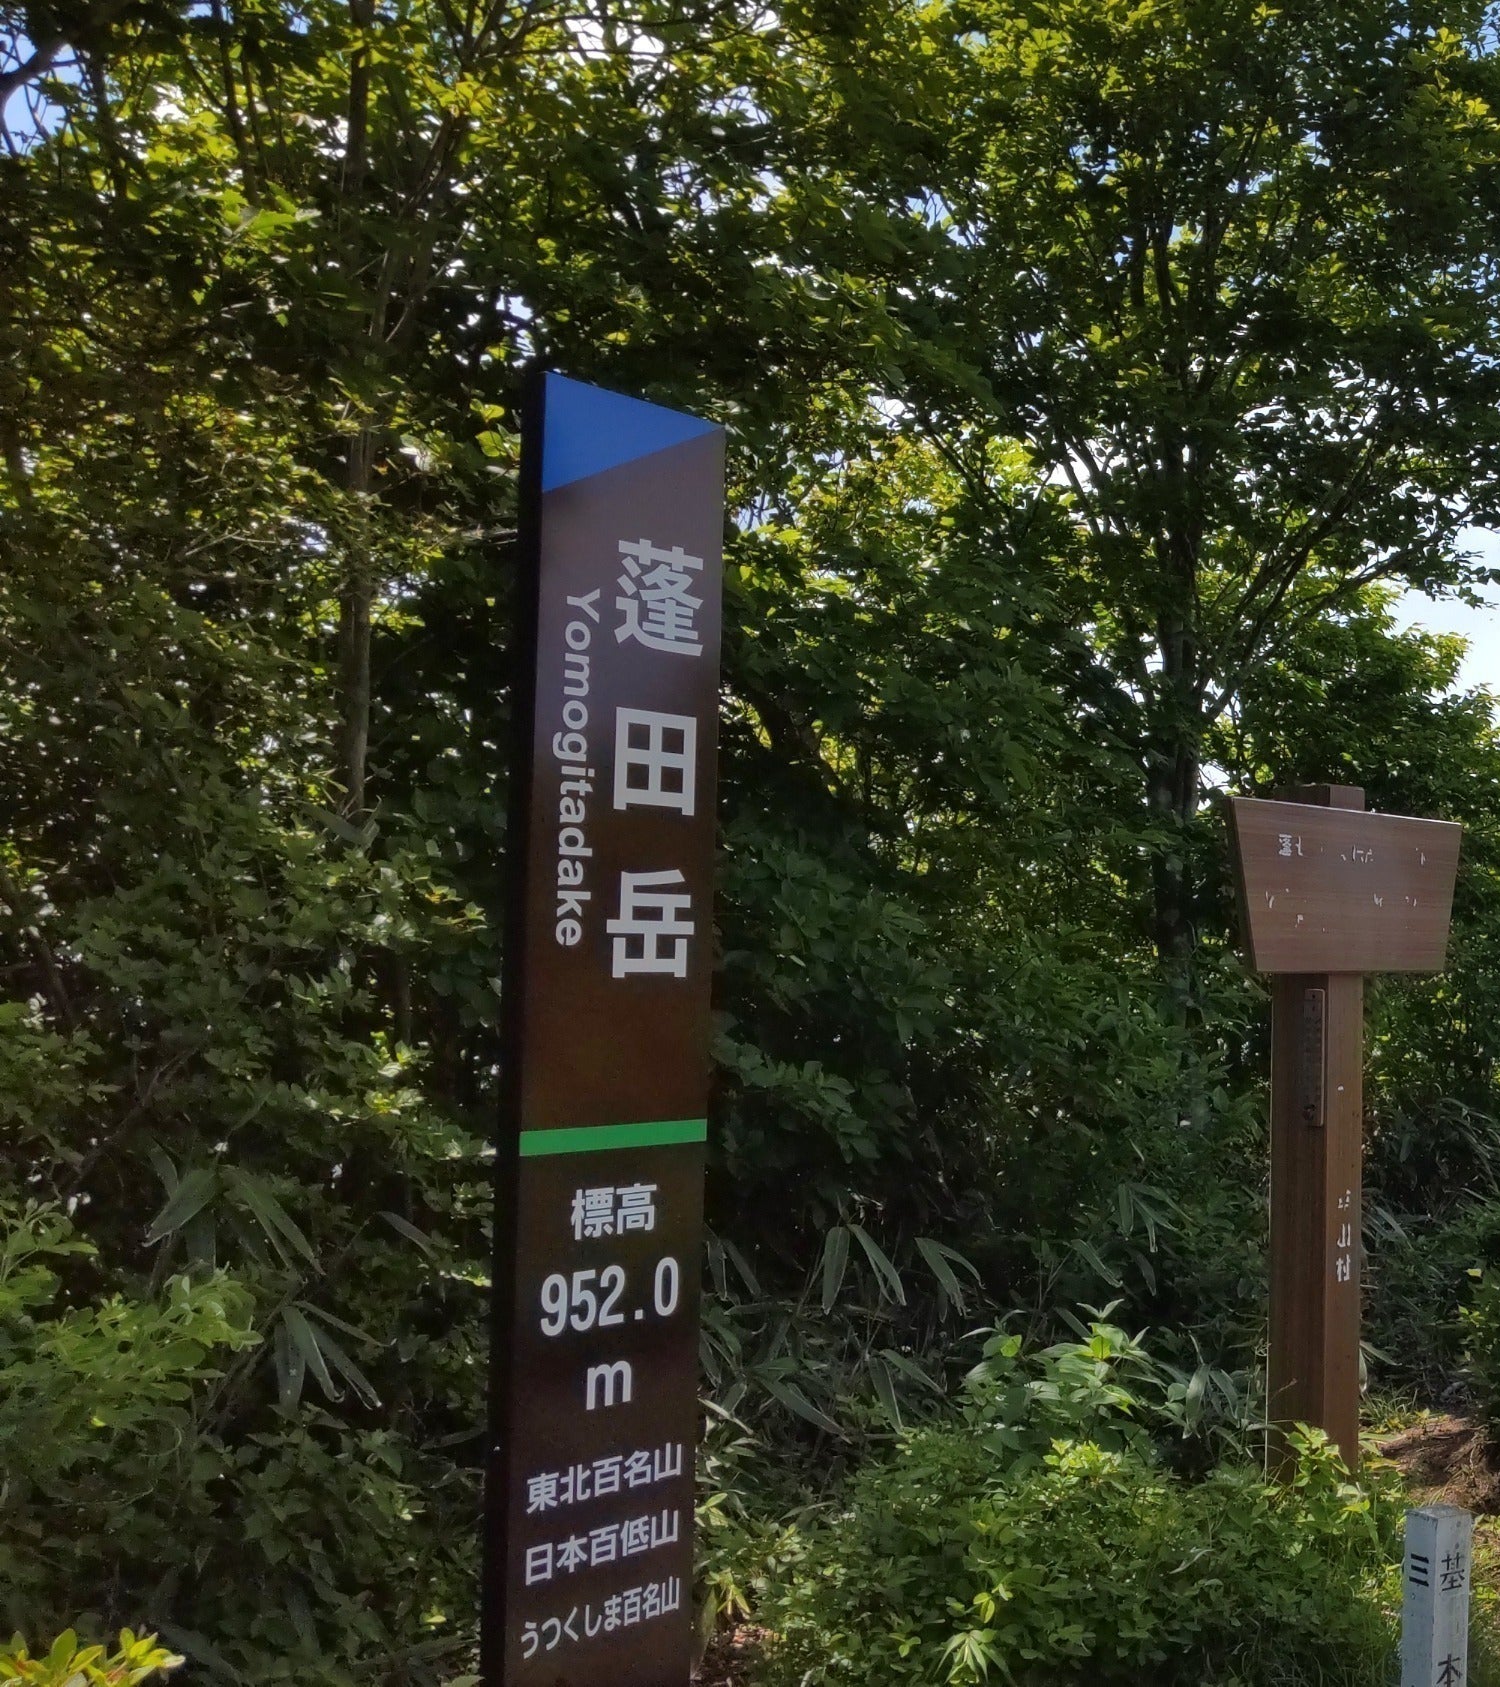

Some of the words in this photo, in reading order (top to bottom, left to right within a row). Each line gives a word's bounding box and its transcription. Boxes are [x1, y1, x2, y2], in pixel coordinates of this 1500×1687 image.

[552, 588, 601, 946] Yomogitadake
[606, 538, 703, 979] 蓬田岳
[571, 1183, 657, 1240] 標高
[540, 1256, 679, 1337] 952.0
[526, 1442, 682, 1514] 東北百名山
[525, 1509, 679, 1586] 日本百低山
[520, 1576, 680, 1660] うつくしま百名山
